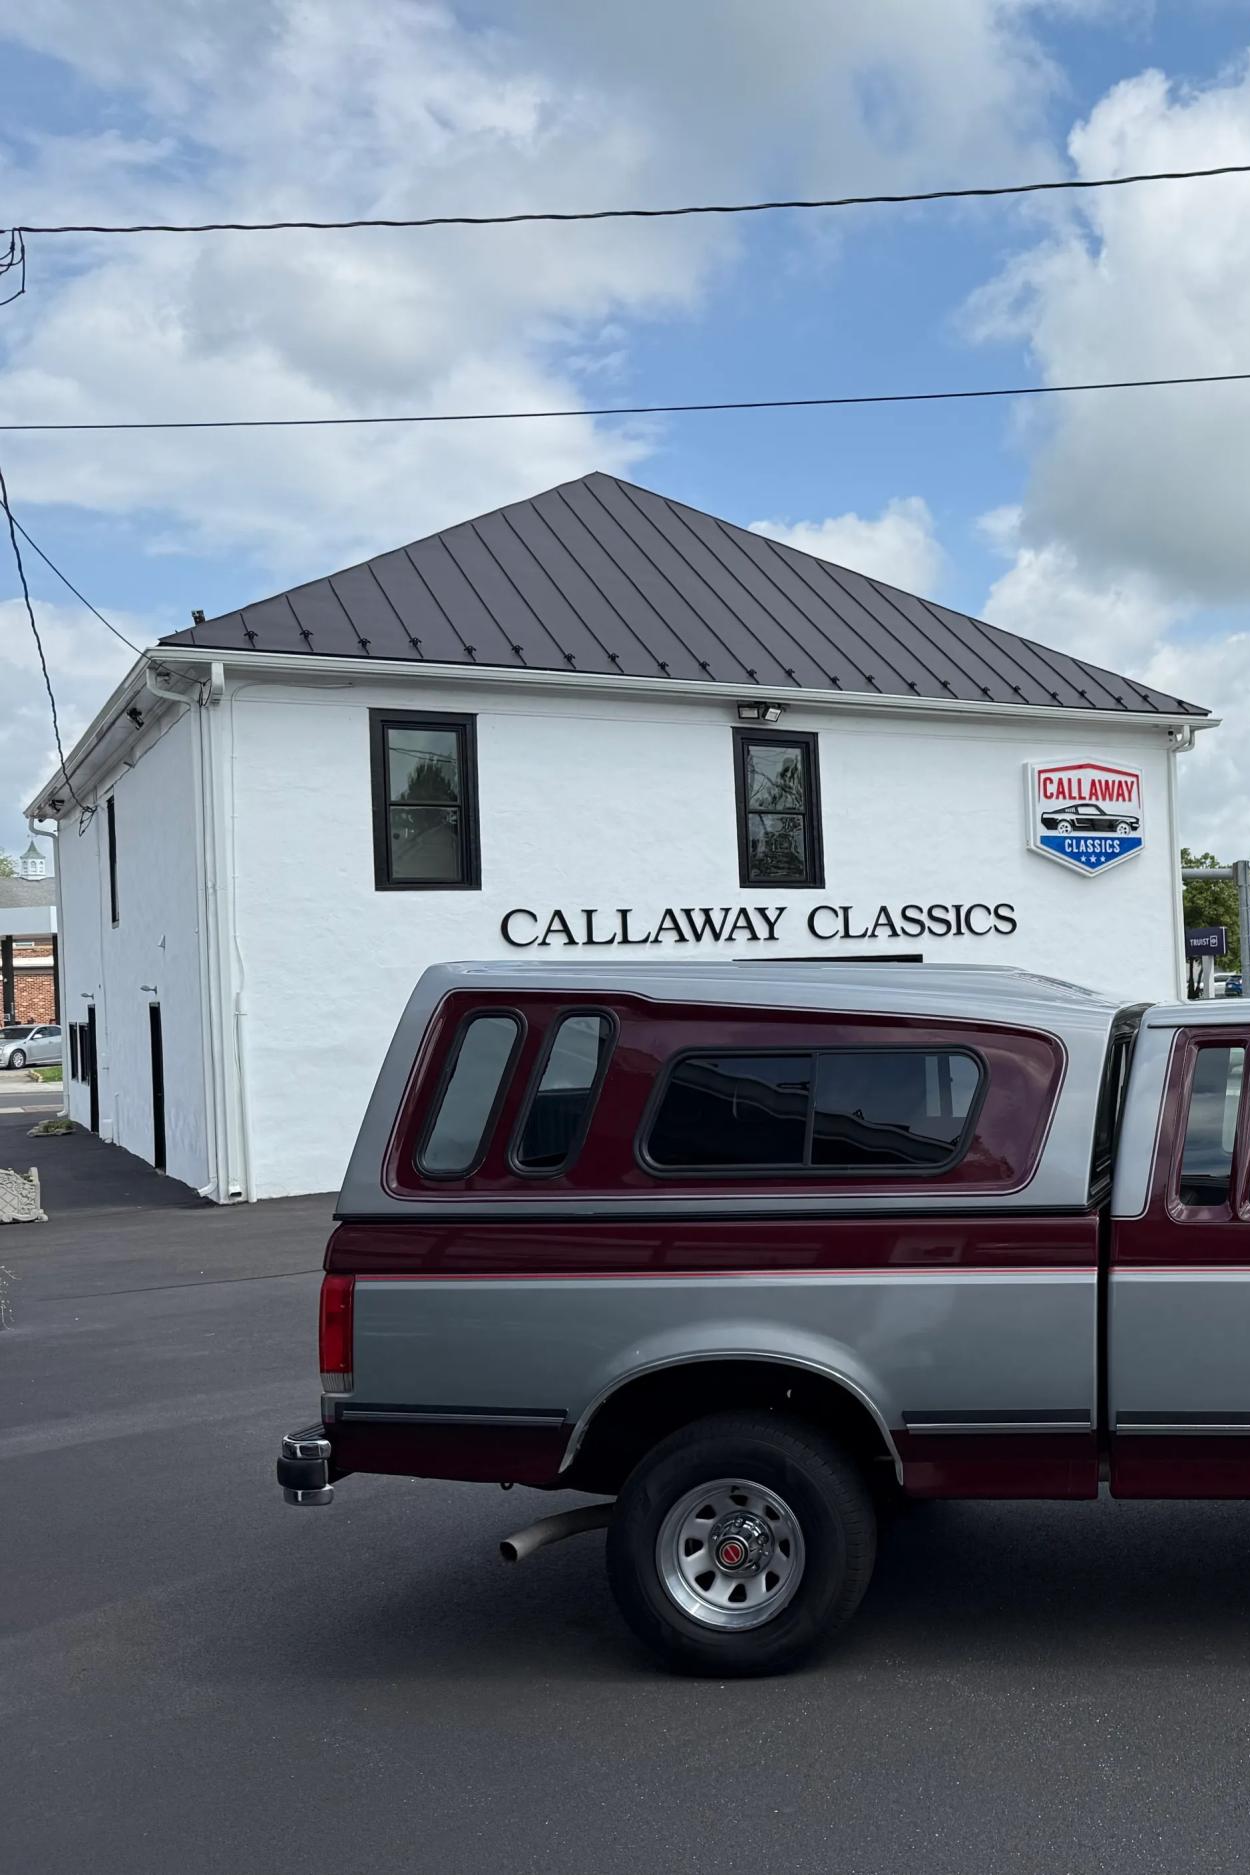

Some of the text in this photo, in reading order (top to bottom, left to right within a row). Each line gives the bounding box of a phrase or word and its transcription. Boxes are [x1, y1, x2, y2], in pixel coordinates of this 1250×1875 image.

[1042, 776, 1135, 802] CALLAWAY
[1064, 838, 1120, 853] CLASSICS
[500, 903, 1018, 947] CALLAWAY CLASSICS
[1189, 937, 1209, 946] TRUIST
